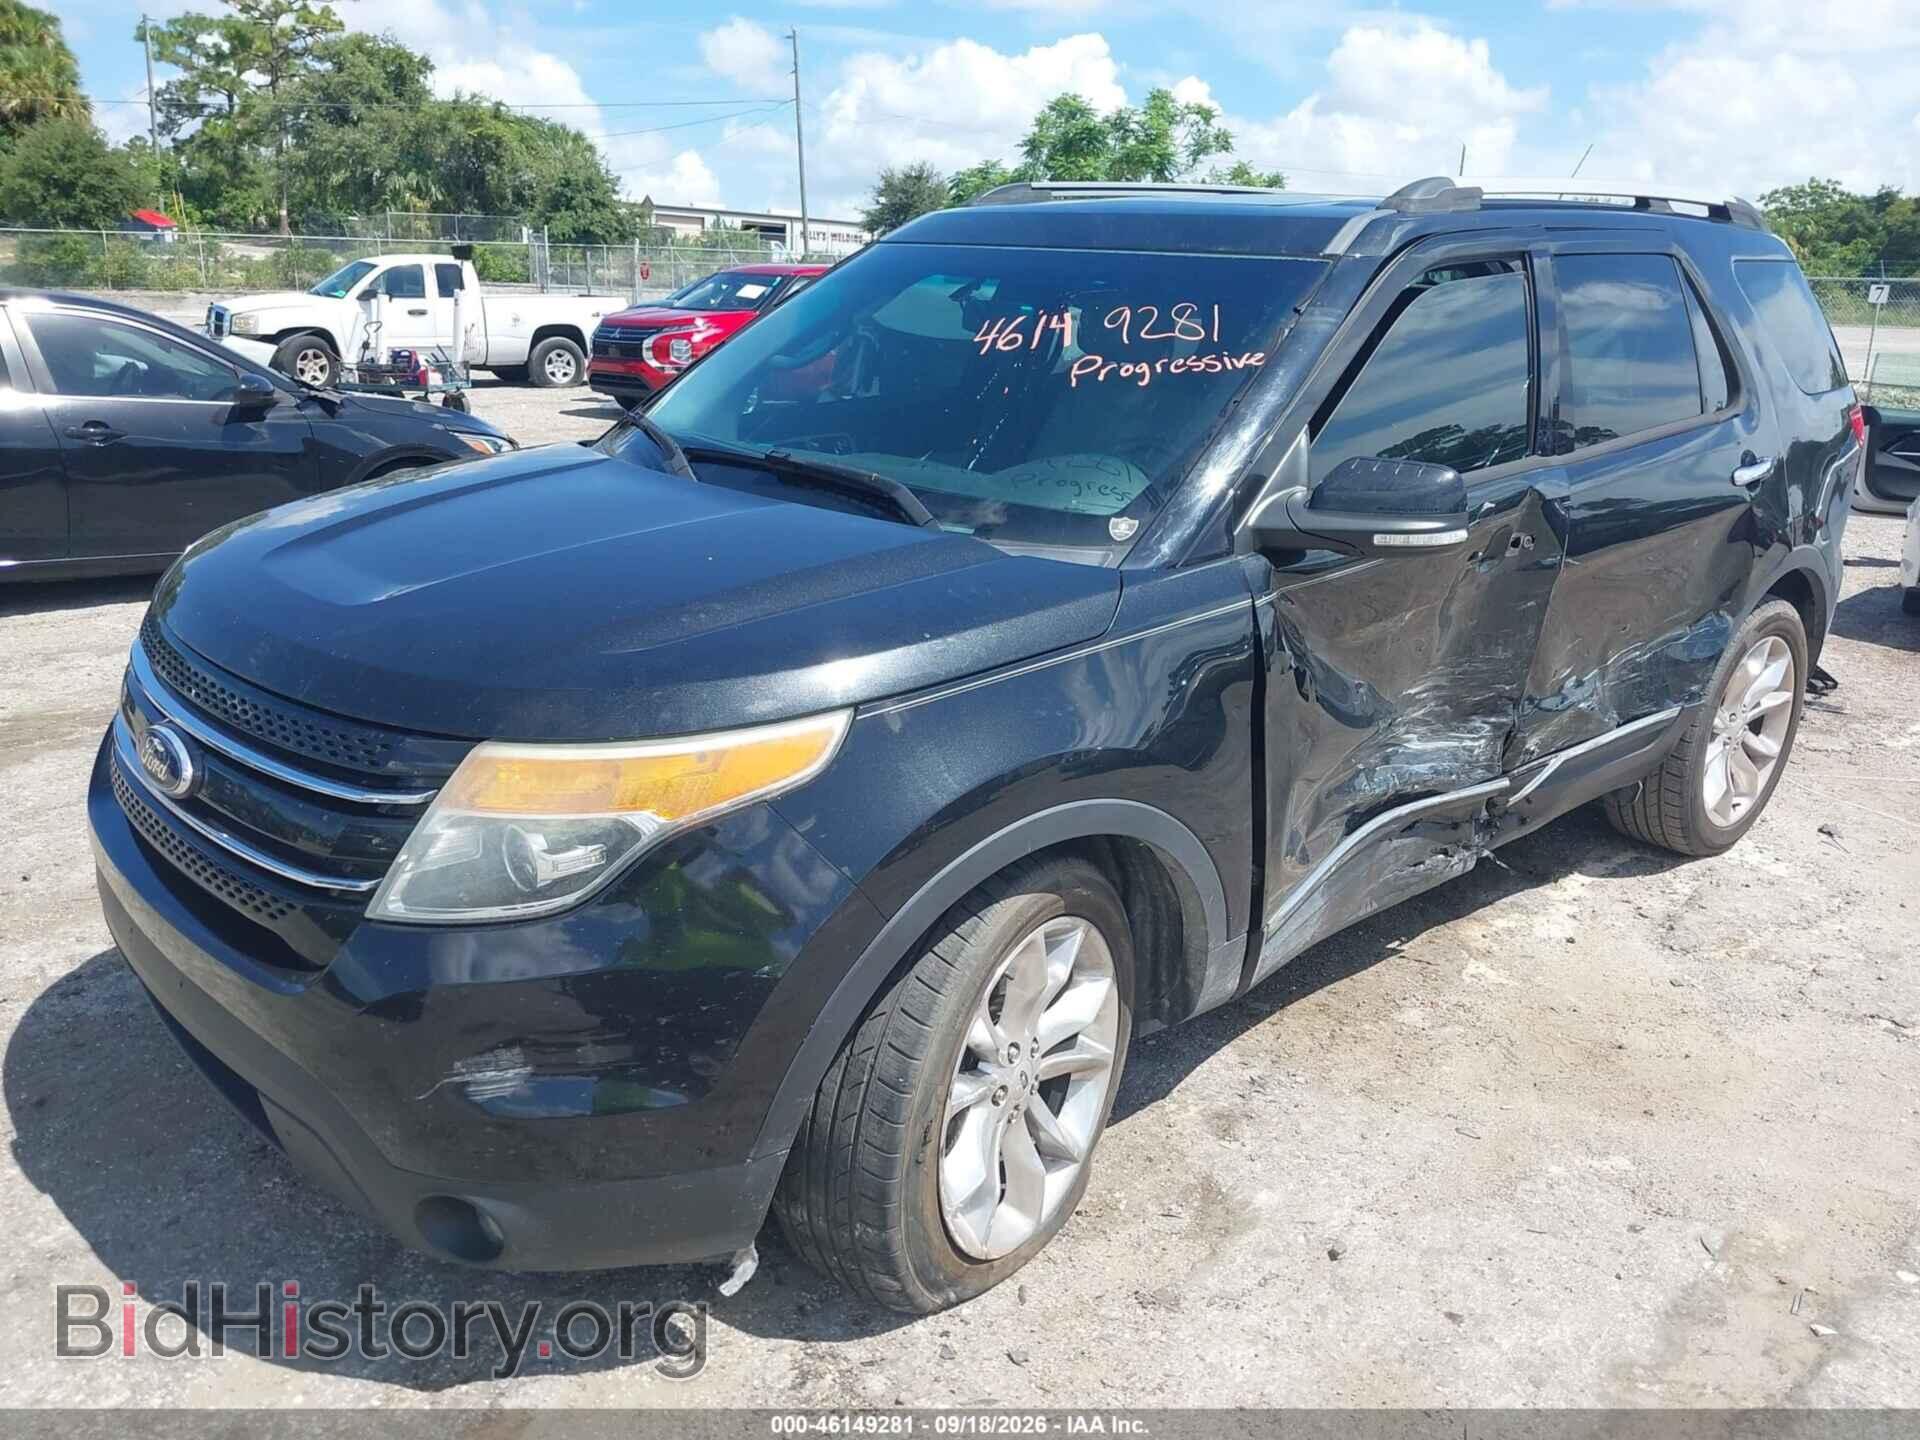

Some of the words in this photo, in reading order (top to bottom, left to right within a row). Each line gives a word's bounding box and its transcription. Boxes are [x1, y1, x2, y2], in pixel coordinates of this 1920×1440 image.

[1875, 286, 1885, 301] 7
[973, 310, 1072, 354] 4614
[1103, 303, 1219, 344] 9281
[1070, 351, 1266, 388] Progressive
